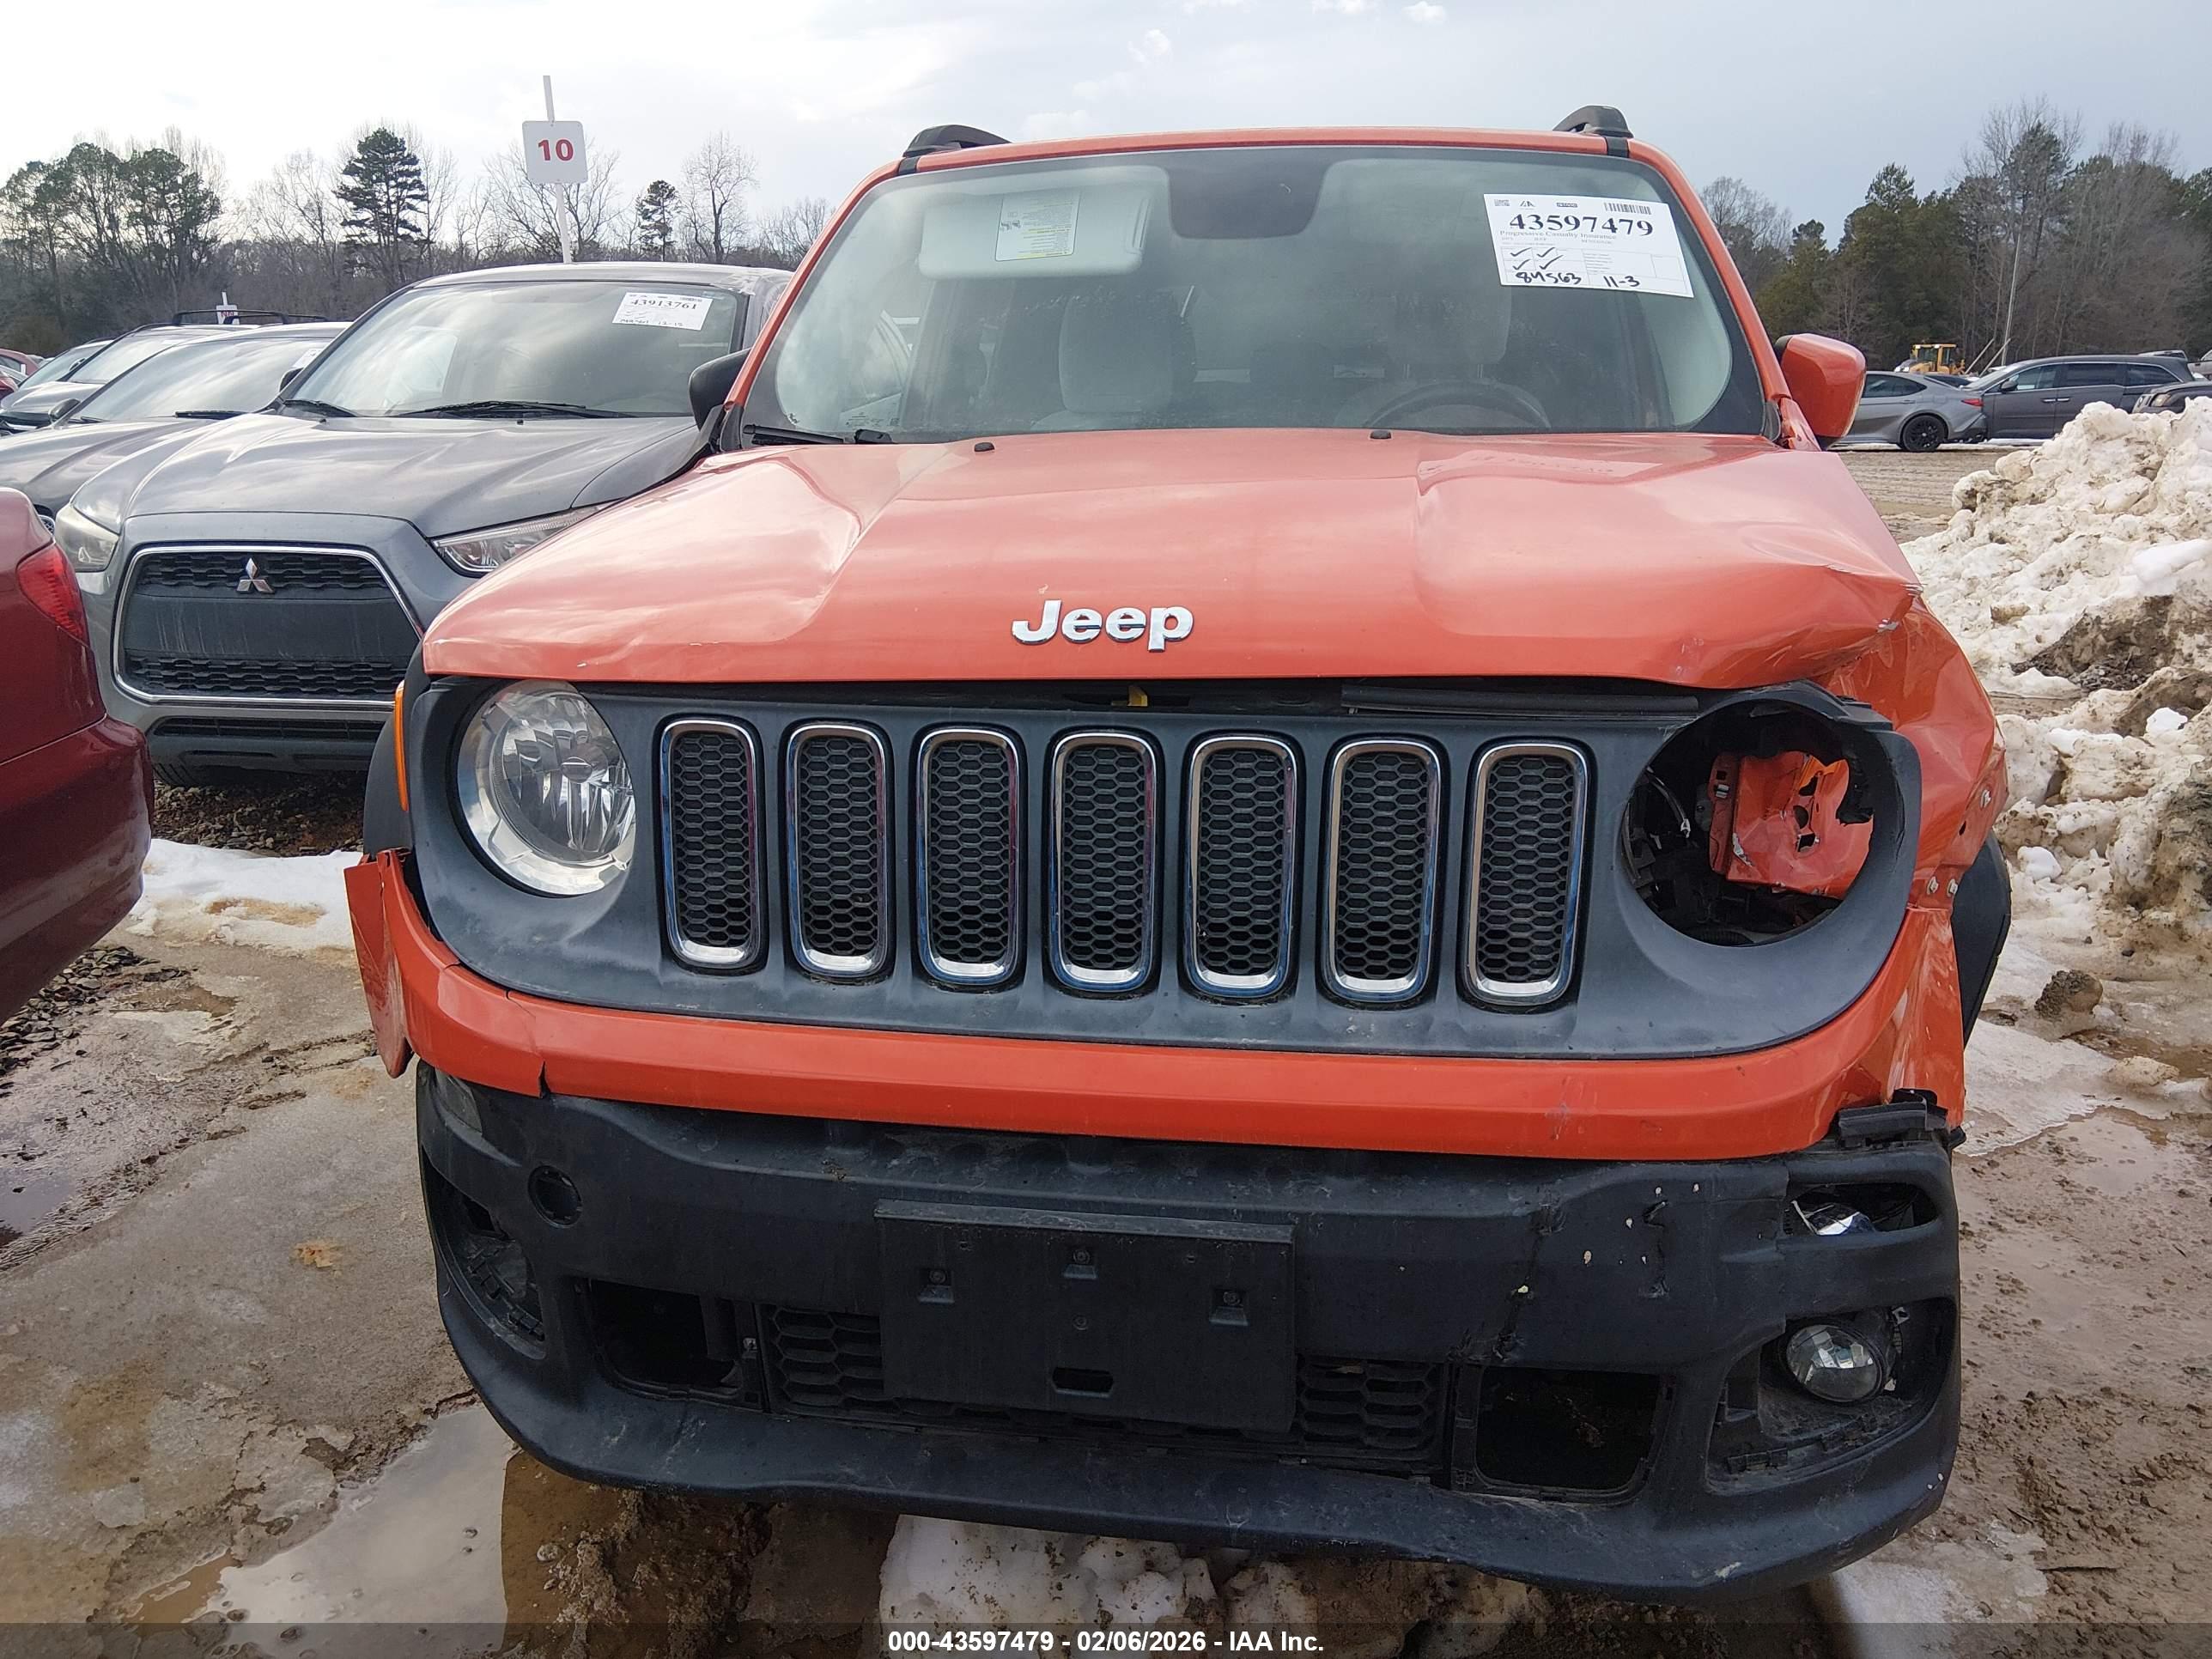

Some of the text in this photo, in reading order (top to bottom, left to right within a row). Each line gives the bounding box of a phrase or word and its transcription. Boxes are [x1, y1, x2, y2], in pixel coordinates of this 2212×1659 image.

[538, 139, 574, 161] 10
[1510, 214, 1653, 236] 43597479
[1603, 276, 1640, 288] 11-3
[631, 299, 697, 310] 43913761
[1012, 599, 1194, 653] Jeep
